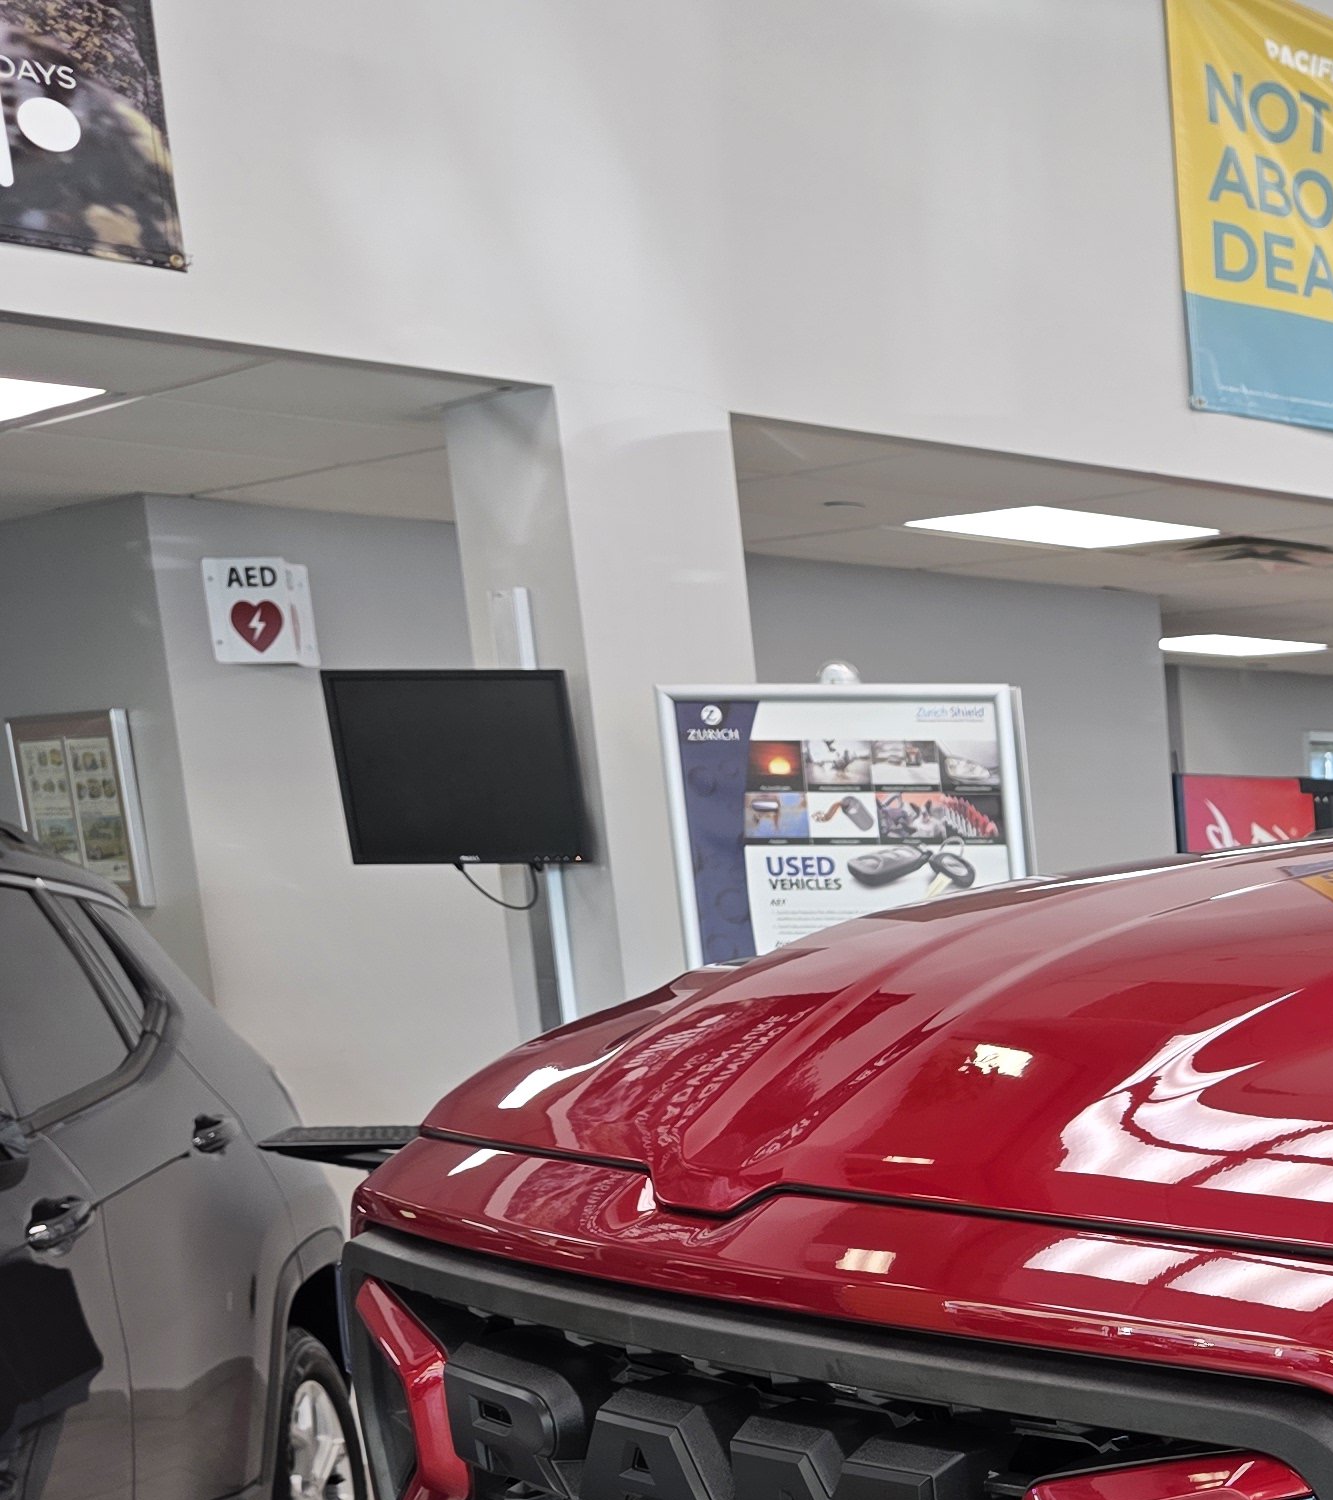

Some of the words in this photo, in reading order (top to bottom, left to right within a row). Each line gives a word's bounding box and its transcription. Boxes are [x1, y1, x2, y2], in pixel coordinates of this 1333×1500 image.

[227, 566, 278, 588] AED
[766, 856, 836, 877] USED
[769, 878, 842, 891] VEHICLES
